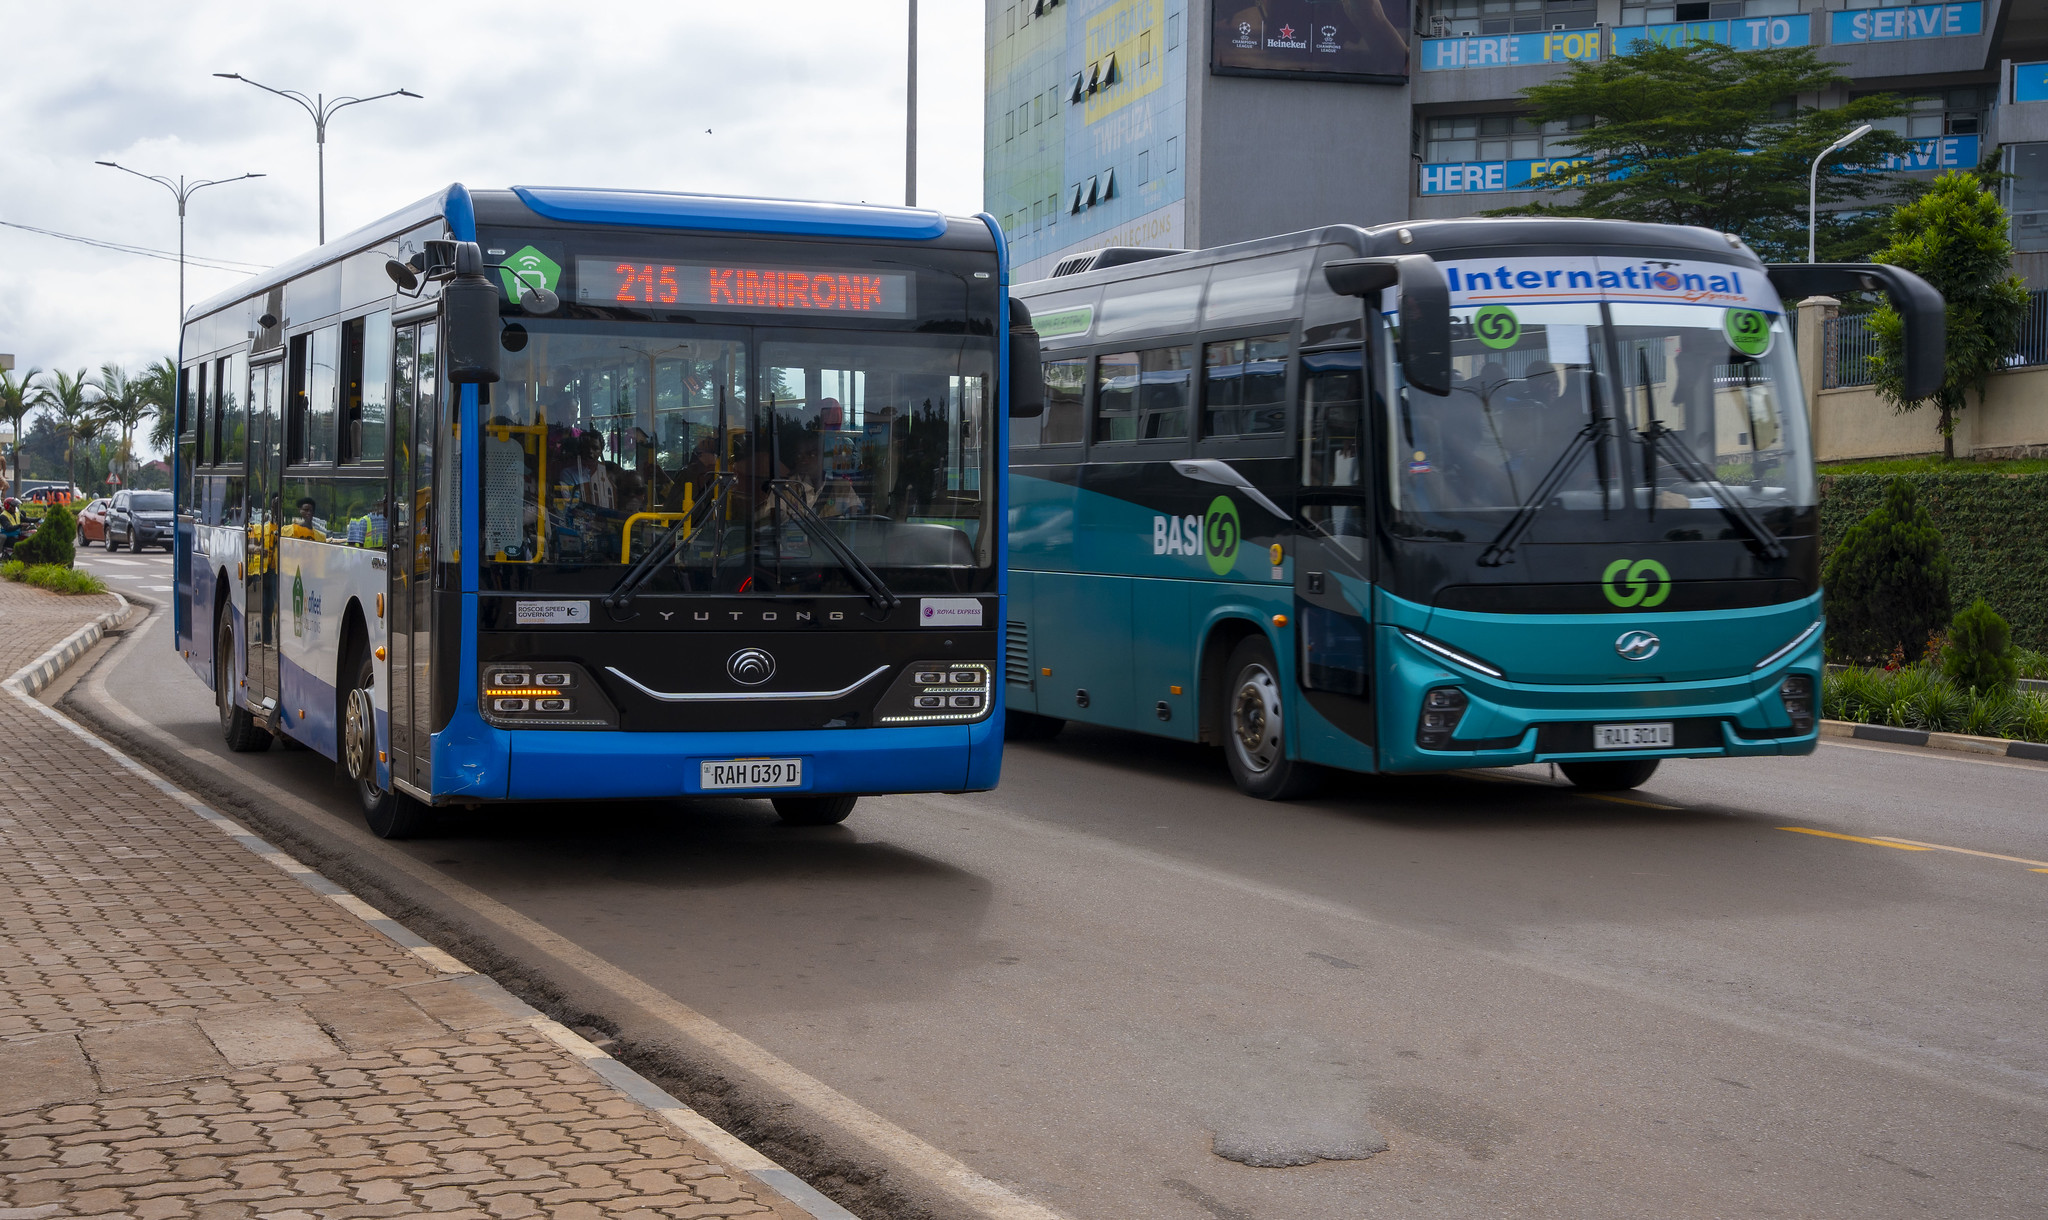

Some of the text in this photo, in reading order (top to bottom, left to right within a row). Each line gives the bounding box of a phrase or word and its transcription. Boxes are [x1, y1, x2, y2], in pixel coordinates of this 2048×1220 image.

[1267, 38, 1307, 49] Heineken
[1436, 5, 1962, 66] HERE FOR YOU TO SERVE
[1422, 164, 1504, 192] HERE
[1530, 160, 1592, 186] FOR
[616, 263, 881, 310] 215 KIMIRONK
[1446, 263, 1743, 295] International
[659, 611, 844, 621] YUTONG
[714, 763, 796, 784] RAH 039 D
